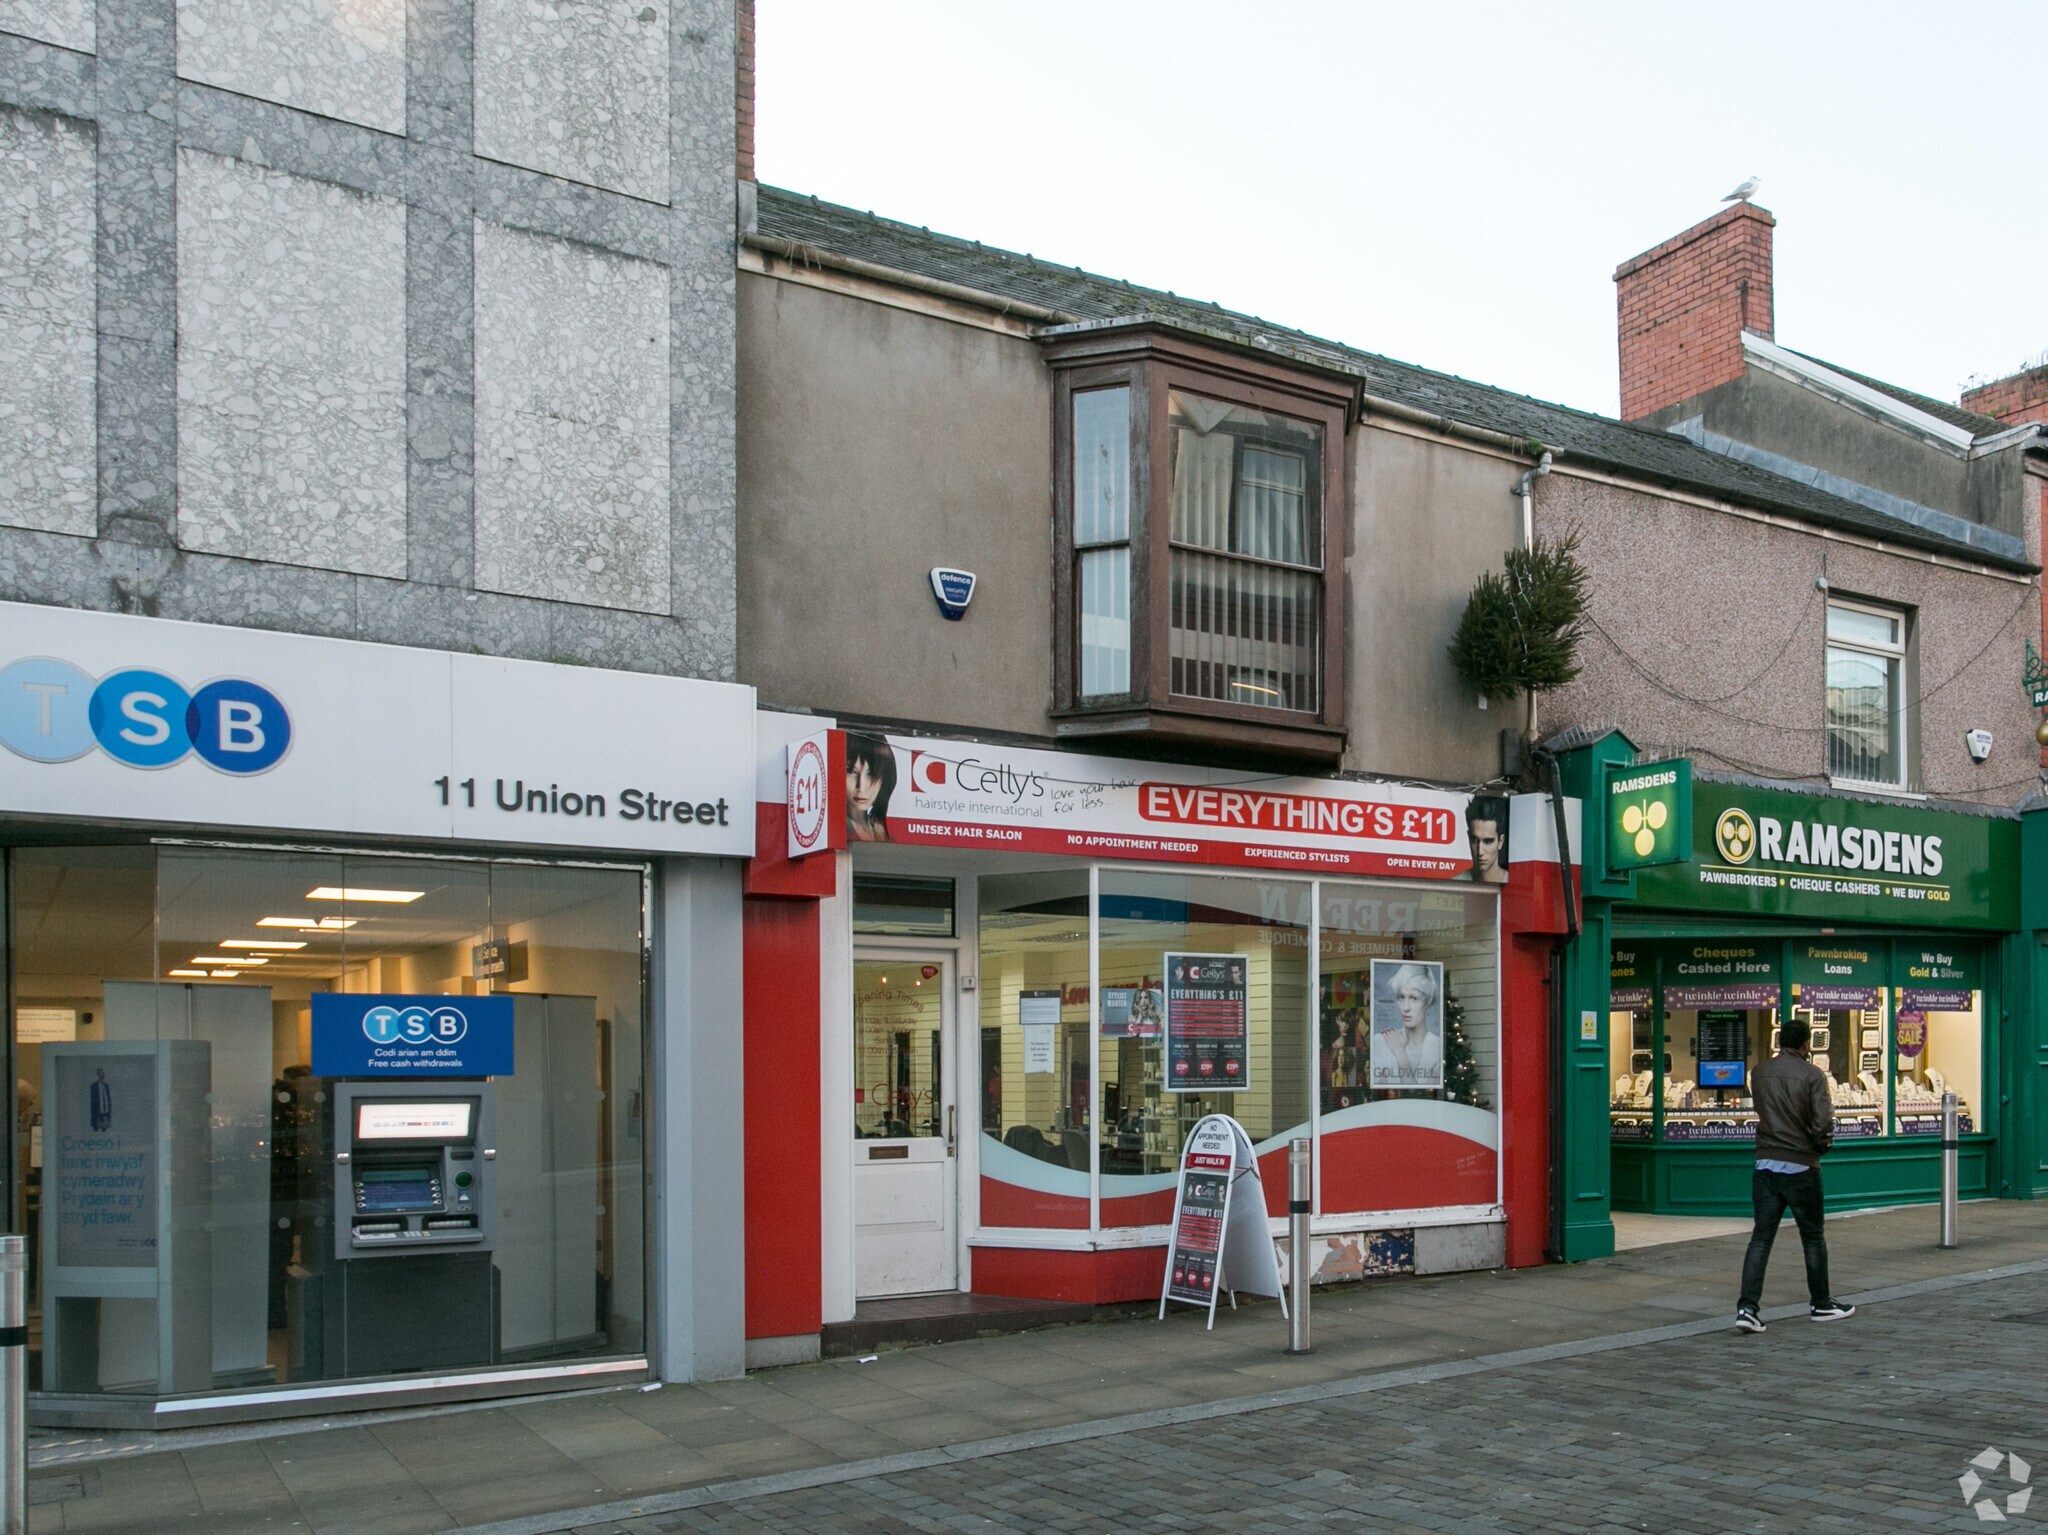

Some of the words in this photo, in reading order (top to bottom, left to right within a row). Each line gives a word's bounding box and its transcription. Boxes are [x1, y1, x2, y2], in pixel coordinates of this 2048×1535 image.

[941, 573, 971, 585] defence
[945, 586, 967, 595] security
[22, 681, 266, 754] TSB
[956, 758, 1044, 803] Celly's
[1612, 770, 1677, 794] RAMSDENS
[796, 773, 818, 814] £11
[1050, 788, 1074, 801] love
[1080, 783, 1105, 801] your
[1111, 777, 1137, 790] hair
[434, 776, 475, 807] 11
[496, 778, 606, 816] Union
[618, 788, 729, 827] Street
[915, 796, 966, 813] hairstyle
[969, 800, 1043, 818] international
[1054, 802, 1075, 814] for
[1149, 786, 1394, 836] EVERYTHING'S
[1402, 809, 1448, 841] £11
[908, 823, 951, 836] UNISEX
[954, 826, 983, 838] HAIR
[986, 829, 1022, 841] SALON
[1067, 834, 1083, 845] NO
[1086, 836, 1157, 850] APPOINTMENT
[1160, 841, 1199, 853] NEEDED
[1759, 816, 1943, 876] RAMSDENS
[1244, 847, 1307, 860] EXPERIENCED
[1309, 851, 1350, 864] STYLISTS
[1387, 857, 1410, 868] OPEN
[1412, 859, 1438, 870] EVERY
[1439, 861, 1456, 871] DAY
[1700, 871, 1777, 888] PAWNBROKERS
[1789, 877, 1832, 892] CHEQUE
[1834, 880, 1880, 896] CASHERS
[1892, 886, 1906, 898] WE
[1908, 888, 1927, 900] BUY
[1927, 889, 1950, 901] GOLD
[1617, 951, 1635, 964] Buy
[1693, 947, 1755, 960] Cheques
[1808, 947, 1868, 963] Pawnbroking
[1921, 952, 1934, 963] We
[1936, 953, 1953, 966] Buy
[1610, 966, 1635, 977] ones
[1678, 962, 1731, 974] Cashed
[1735, 961, 1771, 973] Here
[1824, 962, 1853, 975] Loans
[1909, 966, 1930, 978] Gold
[1931, 967, 1939, 978] &
[1940, 968, 1964, 979] Silver
[897, 990, 926, 1013] Times
[1170, 988, 1225, 1000] EVERYTHING'S
[1229, 990, 1244, 1001] £11
[1617, 992, 1643, 1002] twinkle
[1684, 990, 1722, 1001] twinkle
[1724, 990, 1761, 1001] twinkle
[1816, 991, 1839, 1001] twinkle
[1840, 991, 1864, 1001] twinkle
[1916, 994, 1937, 1003] twinkle
[1938, 994, 1960, 1003] twinkle
[375, 1014, 458, 1036] TSB
[1898, 1030, 1922, 1045] SALE
[375, 1048, 396, 1057] Codi
[398, 1048, 419, 1057] arian
[436, 1048, 457, 1057] ddim
[368, 1059, 389, 1068] Free
[390, 1059, 411, 1068] cash
[413, 1058, 463, 1068] withdrawals
[1198, 1133, 1230, 1141] APPOINTMENT
[1688, 1125, 1723, 1135] twinkle
[61, 1134, 114, 1152] Croeso
[1202, 1142, 1221, 1150] NEEDED
[61, 1153, 92, 1169] fanc
[96, 1153, 144, 1172] mwyaf
[1194, 1156, 1205, 1164] JUST
[1206, 1157, 1218, 1165] WALK
[1219, 1158, 1225, 1166] IN
[61, 1172, 145, 1192] cymeradwy
[61, 1190, 115, 1208] Prydain
[62, 1209, 97, 1226] stryd
[1181, 1205, 1212, 1217] EVERYTHING'S
